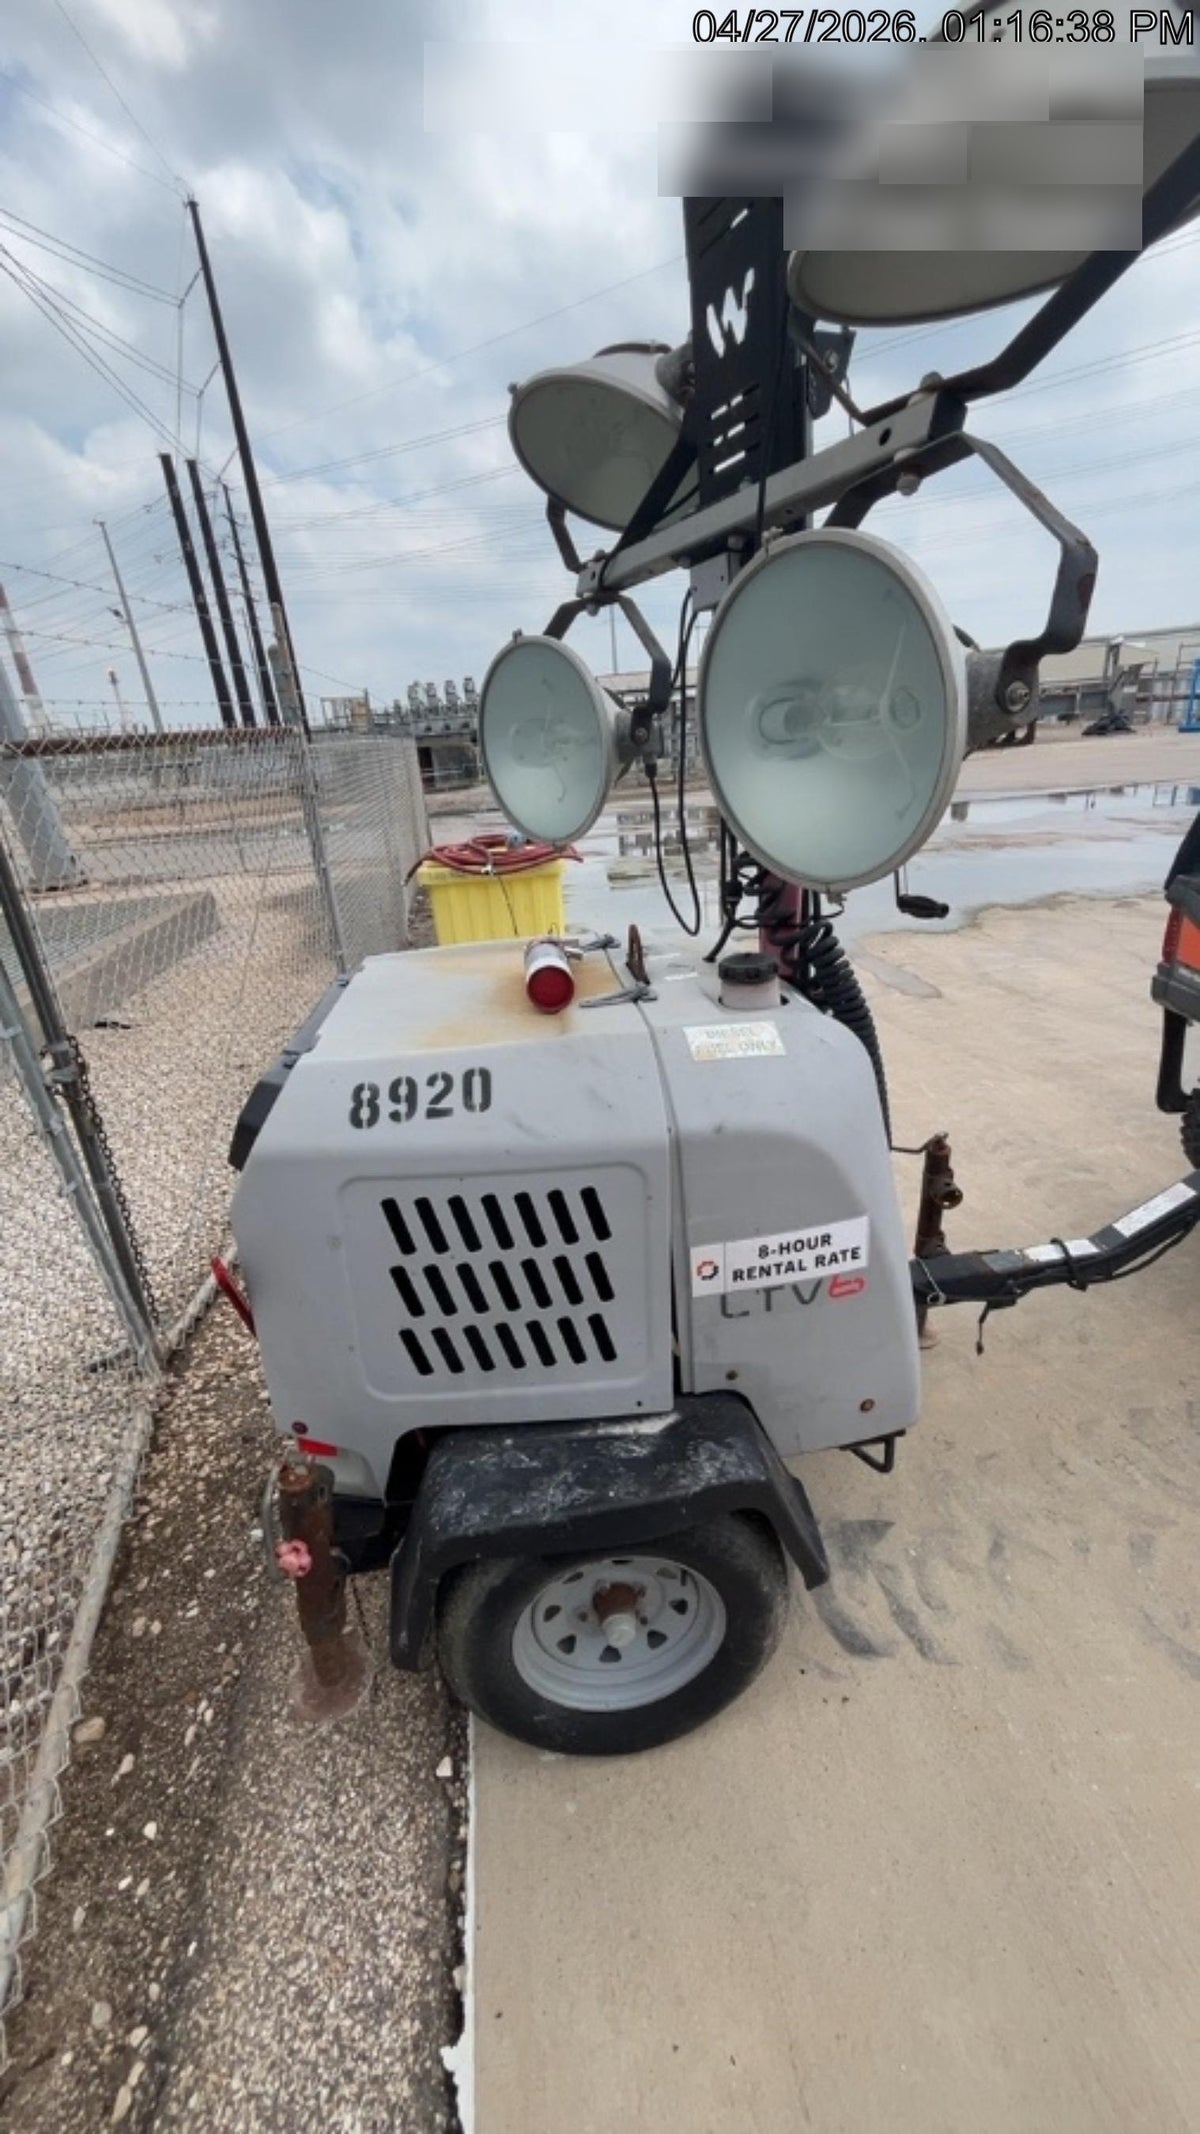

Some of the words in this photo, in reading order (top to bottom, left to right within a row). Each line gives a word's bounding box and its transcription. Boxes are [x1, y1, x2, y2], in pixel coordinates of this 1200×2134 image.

[349, 1066, 492, 1129] 8920
[758, 1233, 832, 1259] 8-HOUR
[732, 1259, 807, 1282] RENTAL
[815, 1247, 861, 1268] RATE
